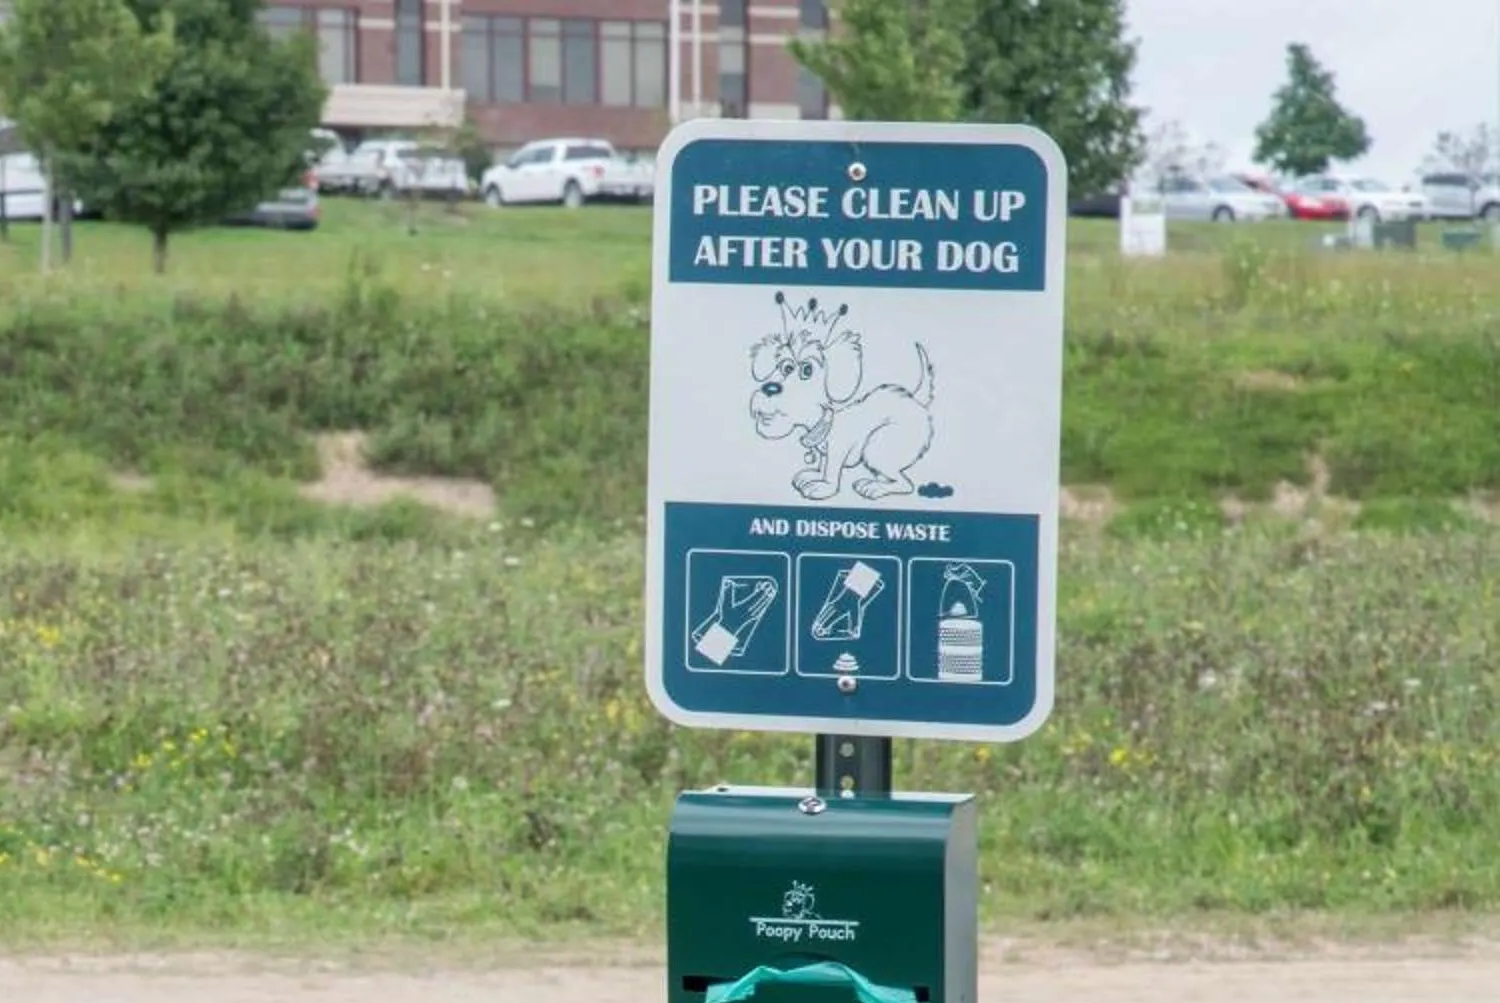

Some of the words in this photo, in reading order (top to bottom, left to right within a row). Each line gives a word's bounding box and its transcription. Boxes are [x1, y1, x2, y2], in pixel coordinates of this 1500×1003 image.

[693, 184, 829, 218] PLEASE
[841, 187, 960, 221] CLEAN
[973, 189, 1026, 222] UP
[693, 235, 809, 269] AFTER
[820, 238, 923, 271] YOUR
[937, 240, 1019, 273] DOG
[749, 517, 789, 536] AND
[795, 519, 881, 539] DISPOSE
[885, 522, 951, 542] WASTE
[756, 921, 802, 942] Poopy
[809, 922, 856, 941] Pouch
